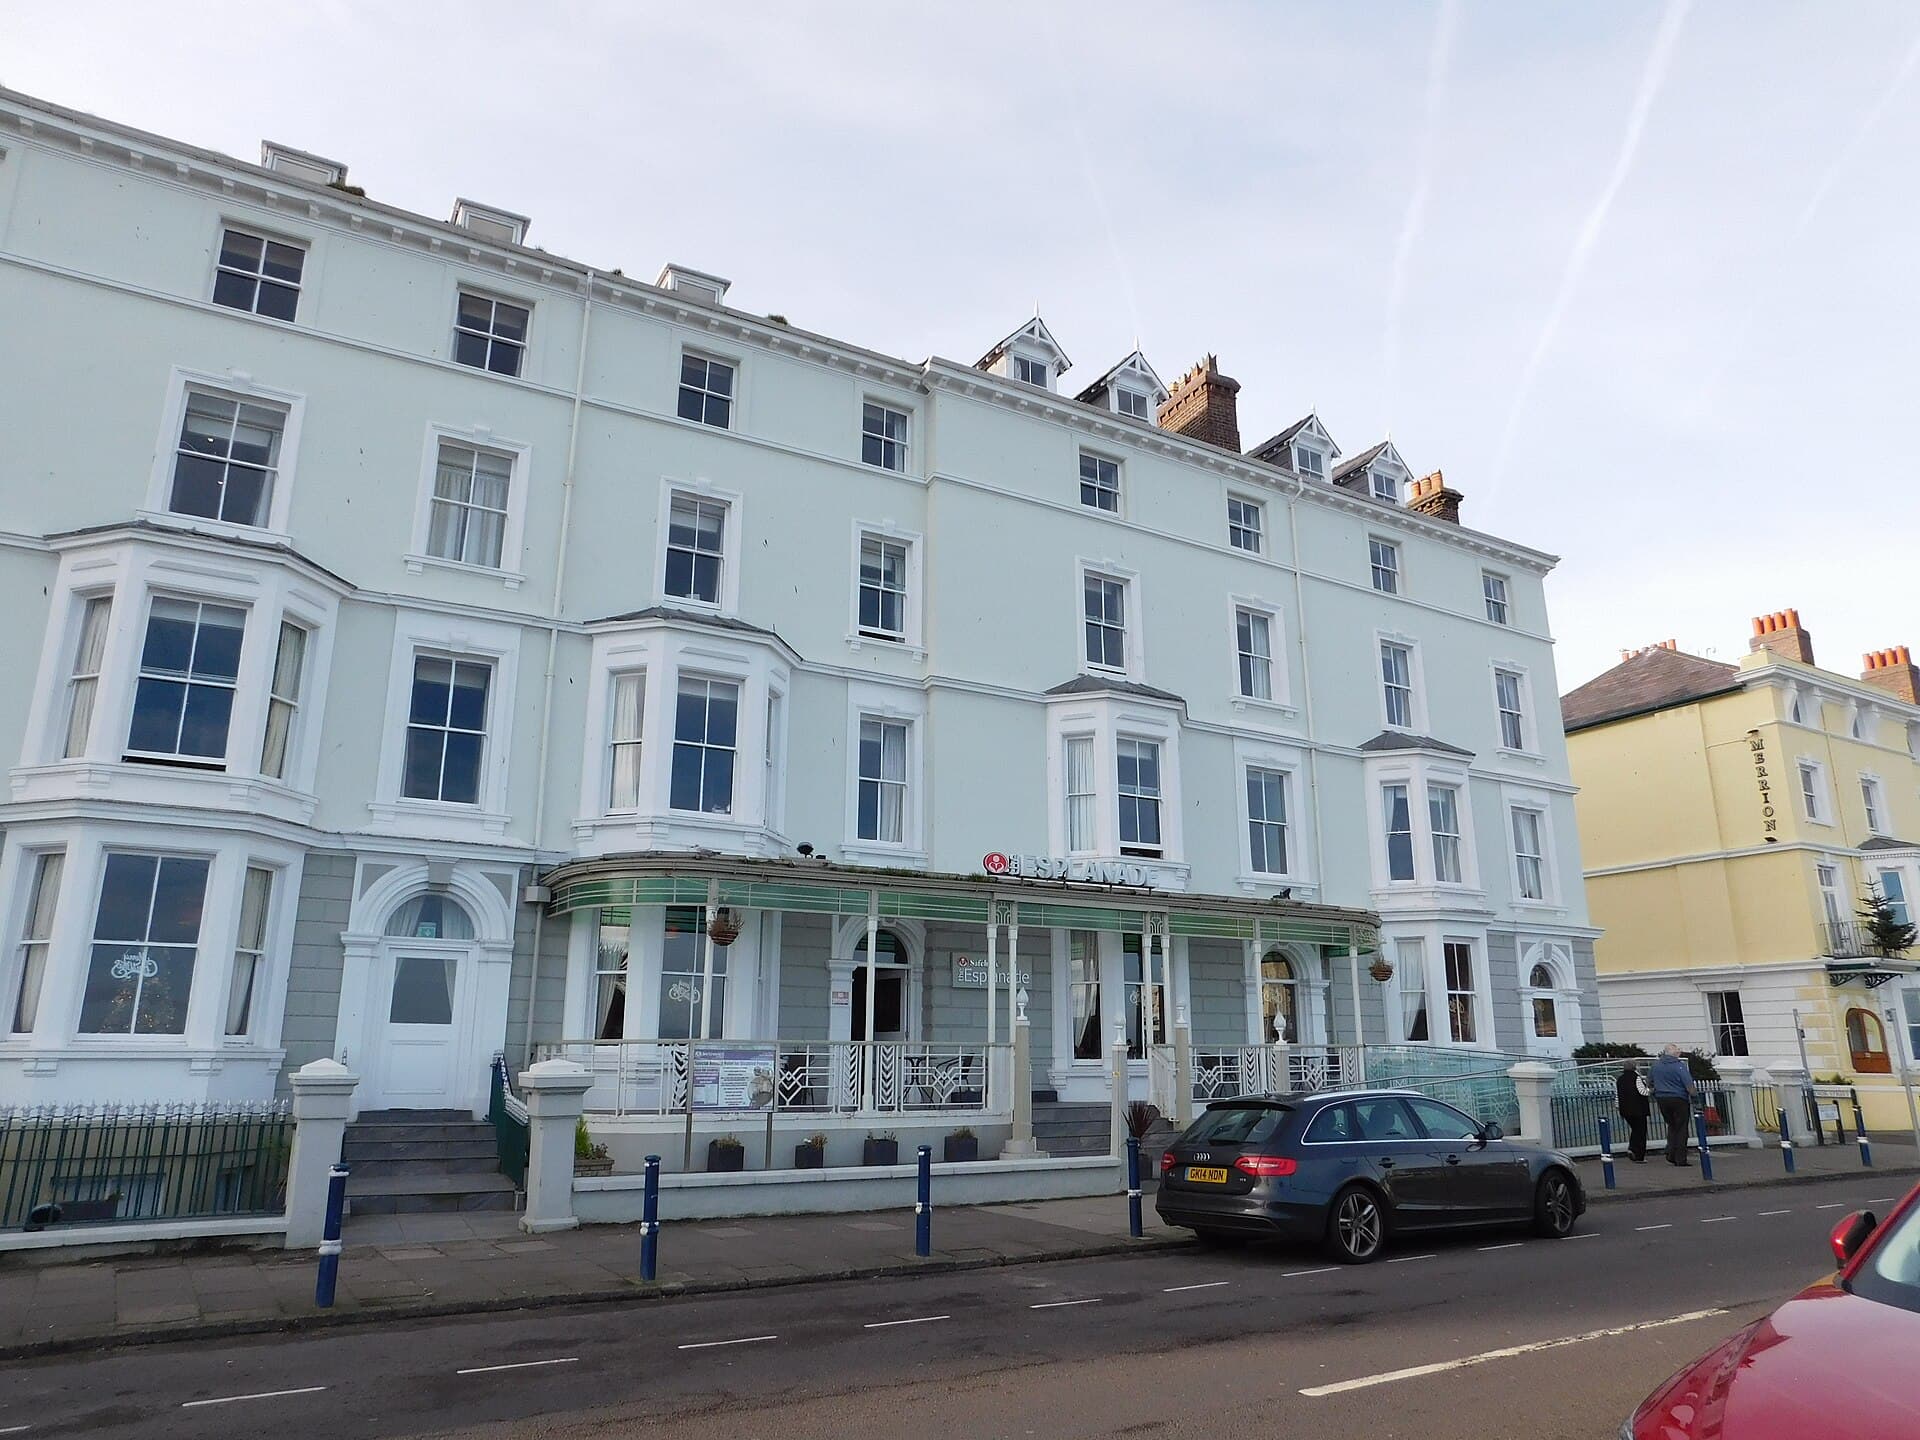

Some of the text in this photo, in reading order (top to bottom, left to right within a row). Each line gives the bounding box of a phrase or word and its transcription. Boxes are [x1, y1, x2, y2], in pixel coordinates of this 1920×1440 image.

[1750, 739, 1777, 831] MERRION
[1020, 854, 1159, 887] ESPLANADE
[1190, 1168, 1224, 1181] GK14 NDN
